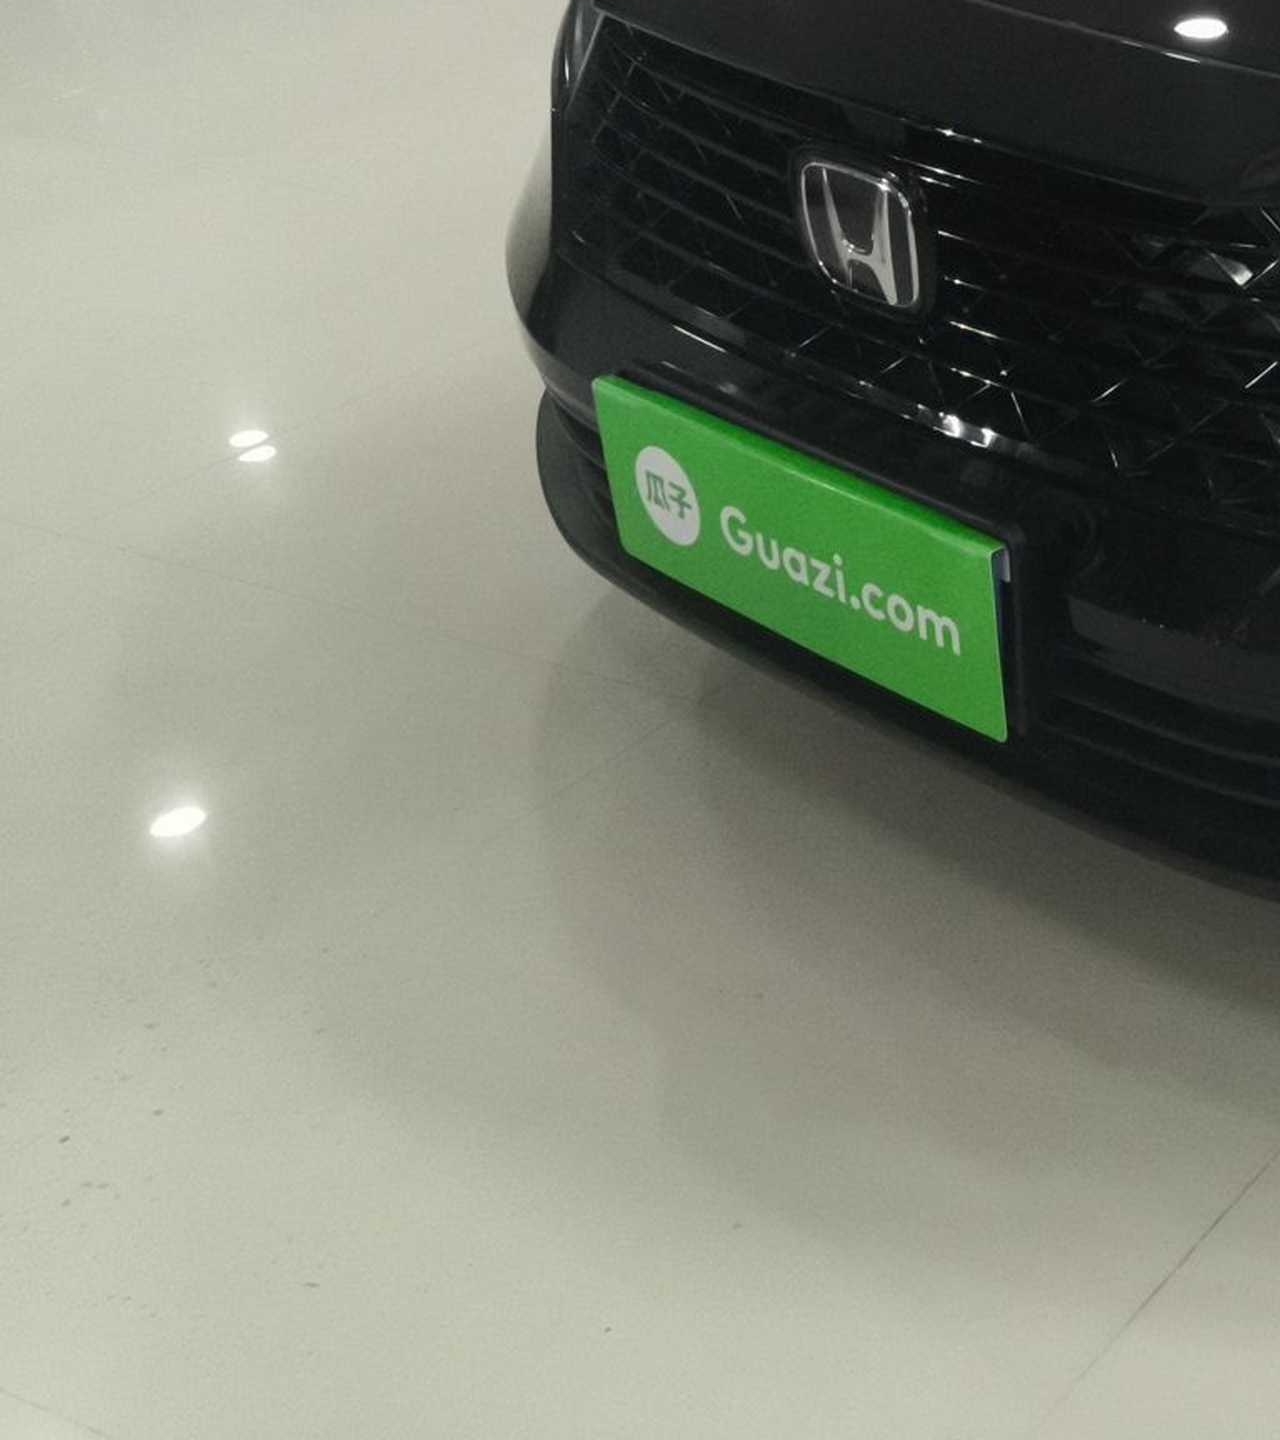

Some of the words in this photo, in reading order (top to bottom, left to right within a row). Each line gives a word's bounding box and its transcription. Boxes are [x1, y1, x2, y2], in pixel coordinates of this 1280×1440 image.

[814, 164, 908, 306] H
[645, 470, 692, 520] 瓜子
[720, 505, 961, 656] Guazi.com
